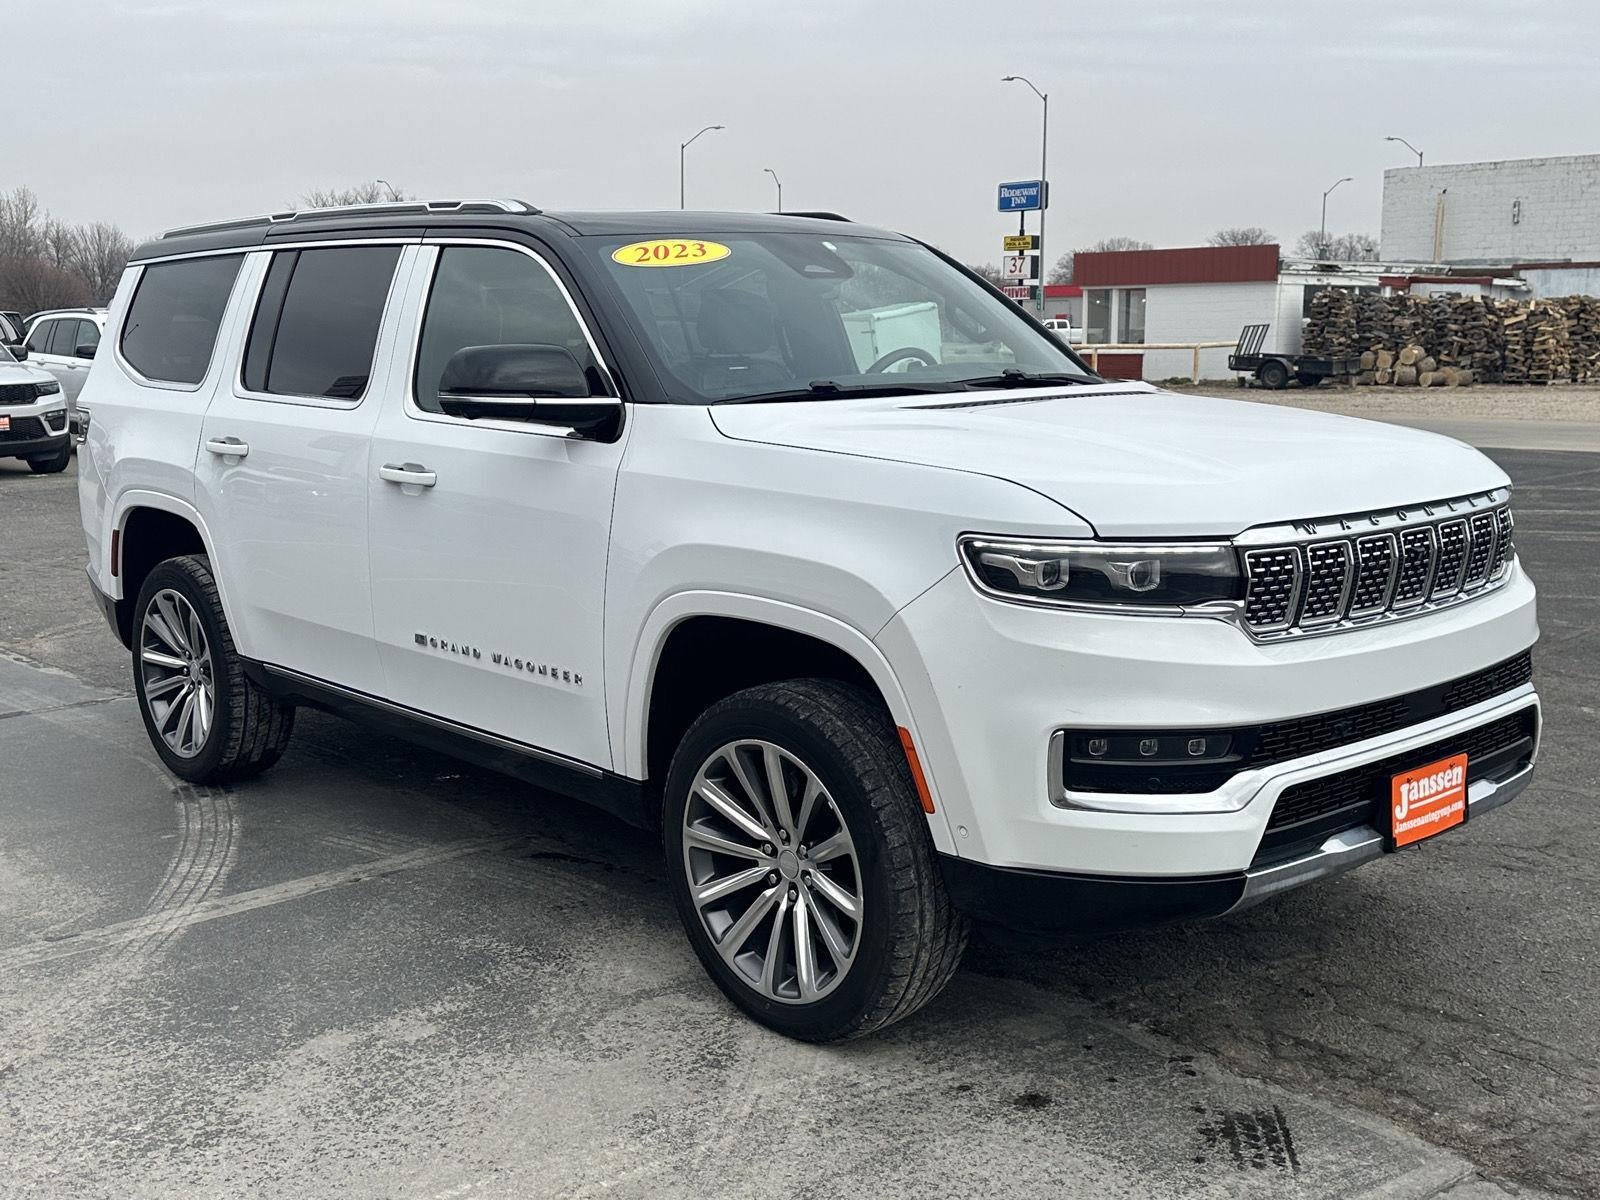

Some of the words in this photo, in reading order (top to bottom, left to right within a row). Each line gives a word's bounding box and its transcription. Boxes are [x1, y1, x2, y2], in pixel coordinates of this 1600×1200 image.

[1001, 187, 1037, 197] RODEWAY
[1011, 196, 1026, 207] INN
[635, 243, 707, 262] 2023
[1009, 257, 1026, 273] 37
[429, 635, 481, 659] GRAND
[491, 651, 583, 686] WAGONEER
[1395, 766, 1463, 819] Janssen
